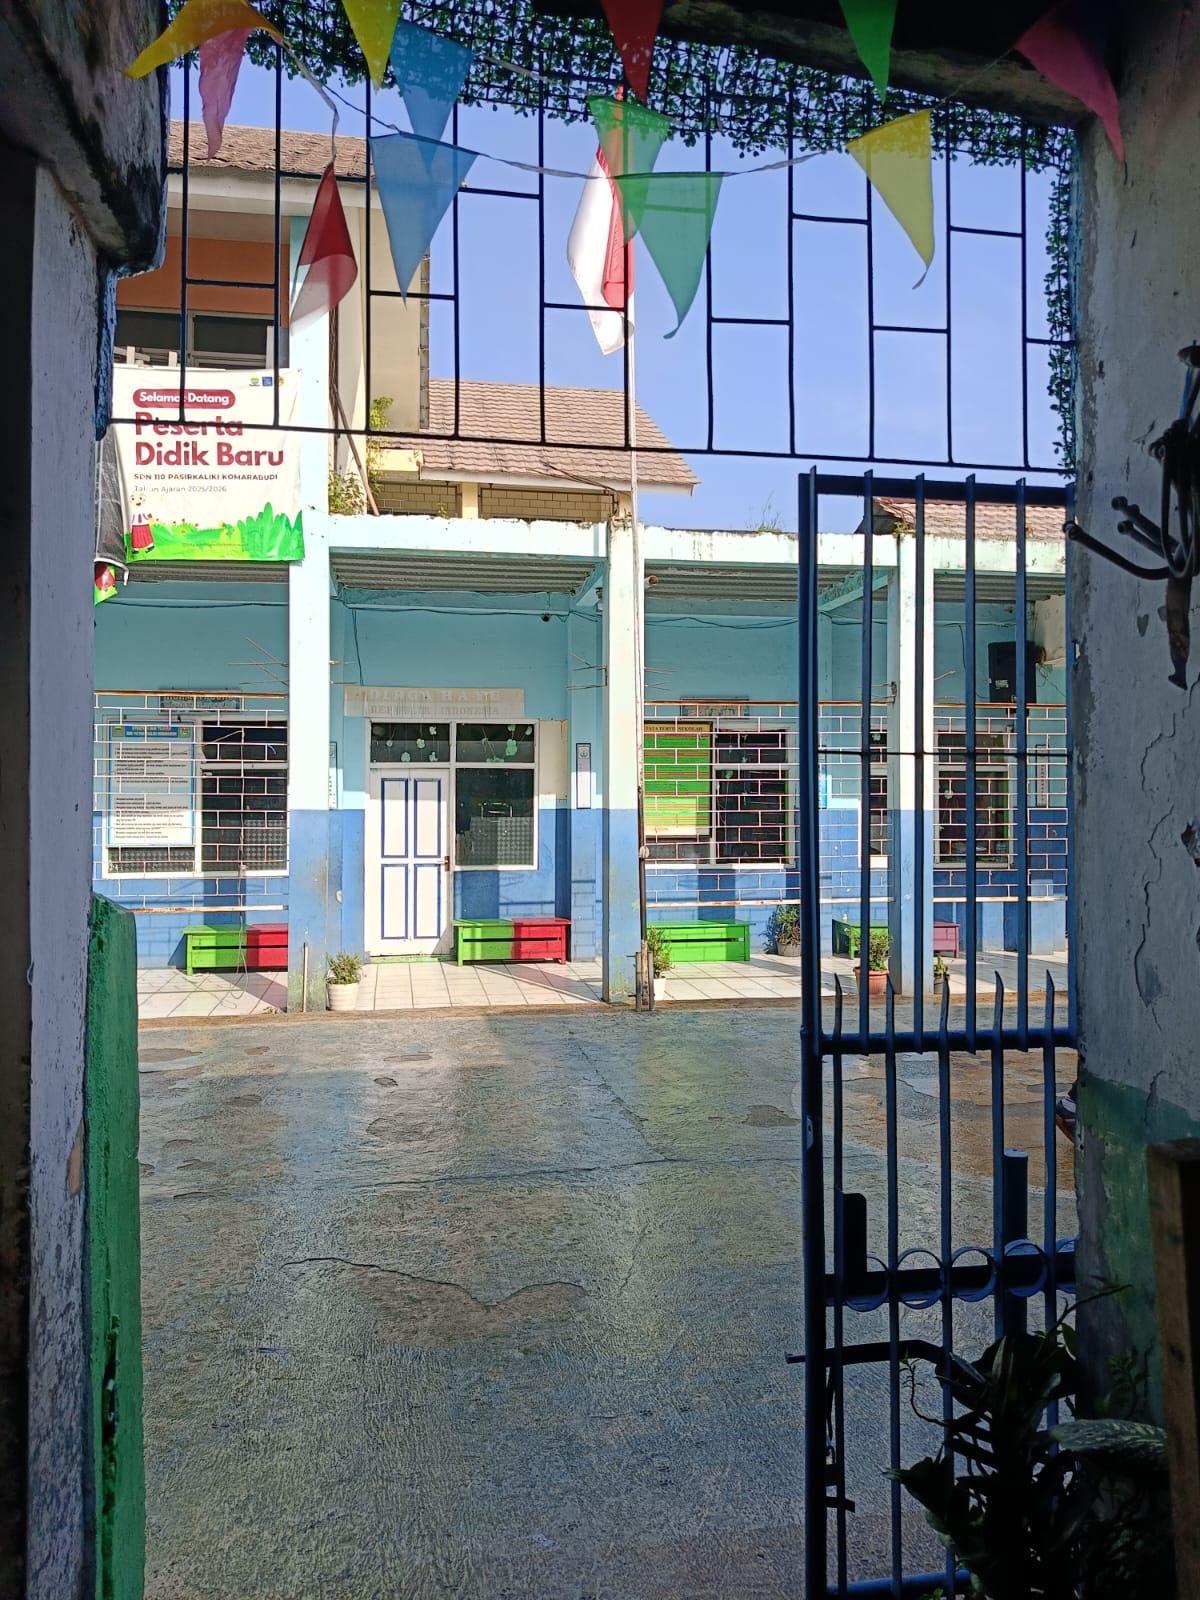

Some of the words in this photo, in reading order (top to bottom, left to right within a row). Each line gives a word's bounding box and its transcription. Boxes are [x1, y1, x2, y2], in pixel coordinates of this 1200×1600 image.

[139, 391, 186, 403] Selama
[188, 392, 230, 405] Datang
[135, 411, 243, 436] Peserta
[135, 440, 210, 466] Didik
[216, 441, 284, 466] Baru
[161, 485, 186, 494] Ajaran
[188, 485, 228, 493] 2025/2026
